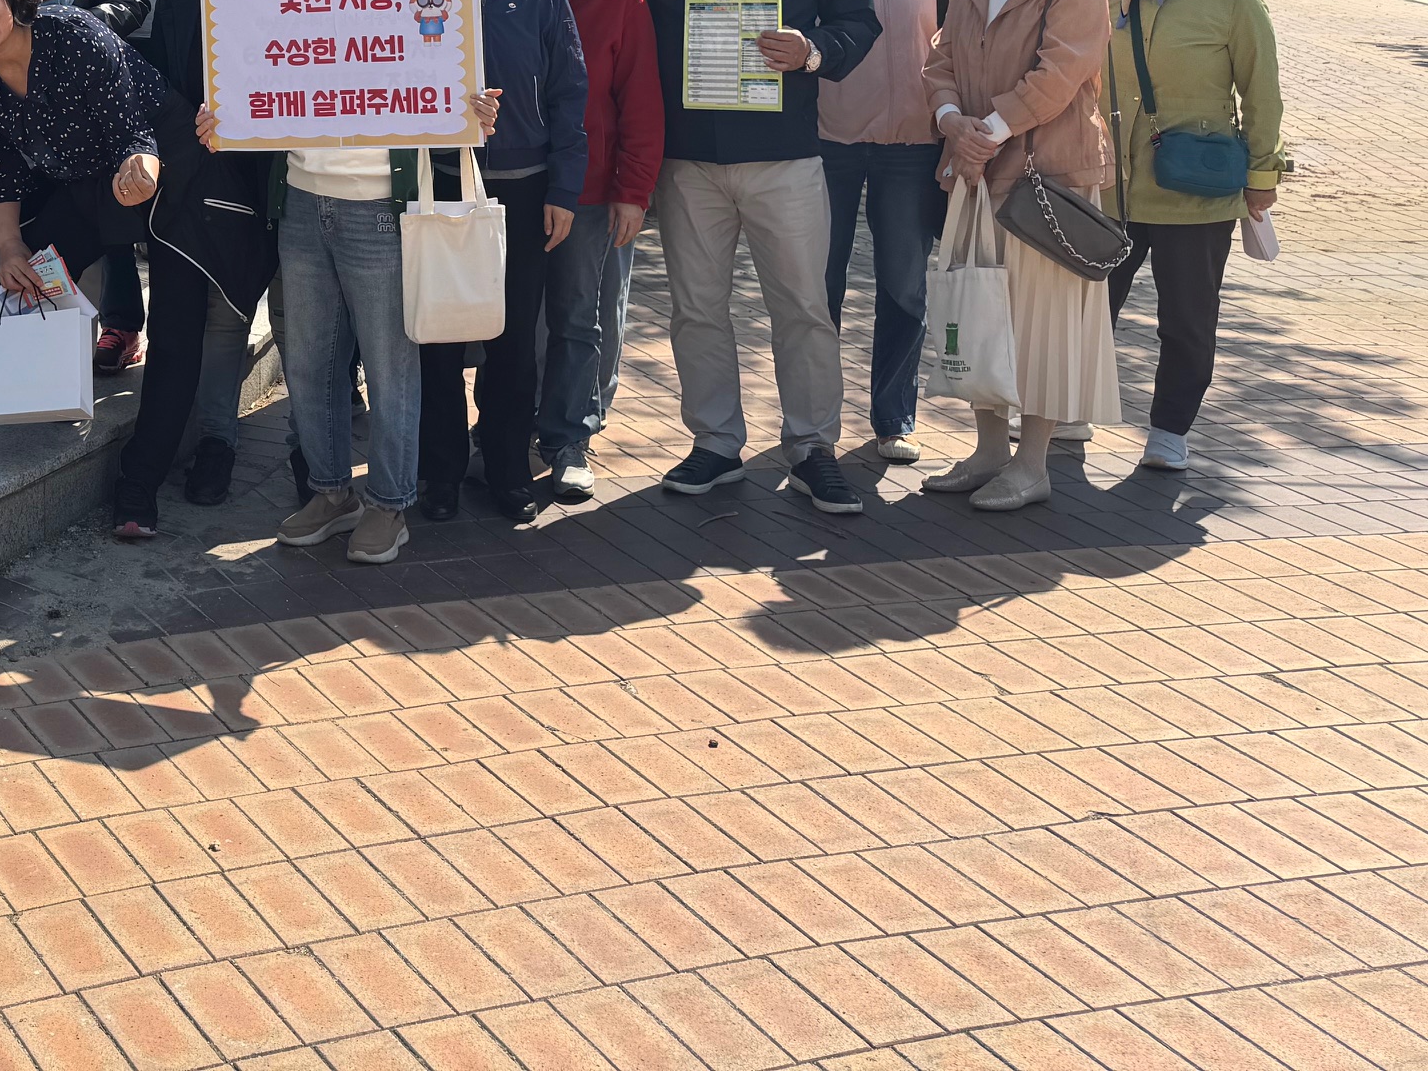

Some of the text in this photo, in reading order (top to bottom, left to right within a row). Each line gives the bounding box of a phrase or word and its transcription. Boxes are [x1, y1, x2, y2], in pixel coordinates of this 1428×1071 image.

[264, 38, 336, 66] 수상한
[345, 35, 404, 63] 시선!
[249, 90, 306, 119] 함께
